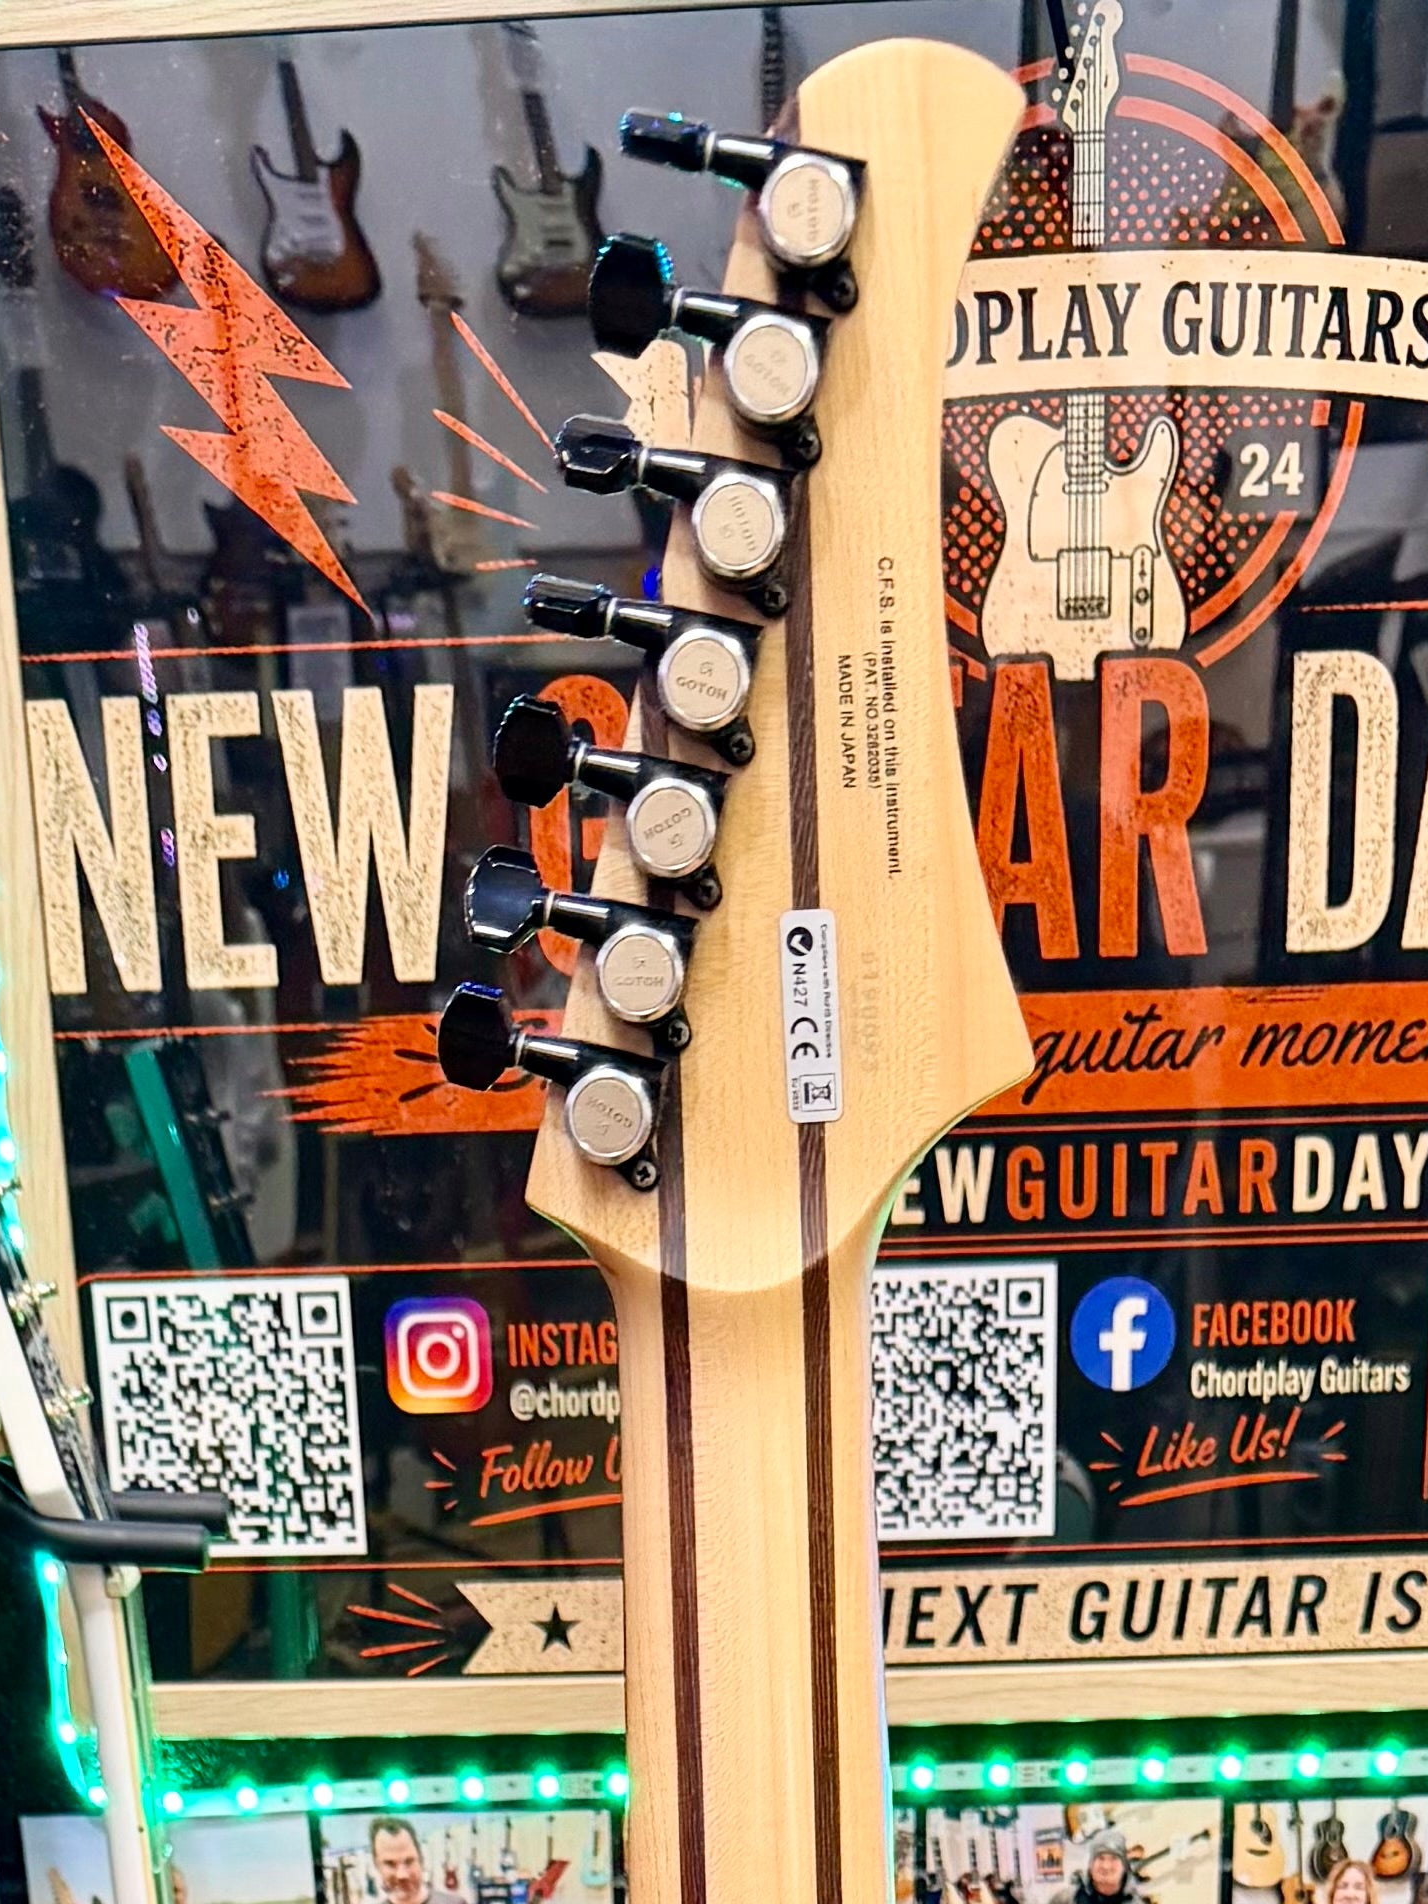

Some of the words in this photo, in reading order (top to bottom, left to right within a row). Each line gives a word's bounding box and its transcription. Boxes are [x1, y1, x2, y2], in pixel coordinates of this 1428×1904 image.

[1238, 442, 1304, 499] 24
[675, 674, 729, 702] GOTOH
[838, 655, 854, 705] MADE
[840, 711, 854, 728] IN
[884, 714, 897, 740] on
[842, 734, 857, 789] JAPAN
[885, 745, 901, 776] this
[24, 683, 455, 994] NEW
[643, 806, 693, 841] GOTOH
[792, 962, 808, 1007] N427
[1022, 1003, 1226, 1106] guitar
[1192, 1298, 1357, 1348] FACEBOOK
[1190, 1353, 1317, 1405] Chordplay
[1319, 1352, 1412, 1395] Guitars
[1137, 1418, 1218, 1478] Like
[1228, 1404, 1303, 1465] Us!
[480, 1439, 594, 1499] Follow
[1068, 1573, 1330, 1645] GUITAR
